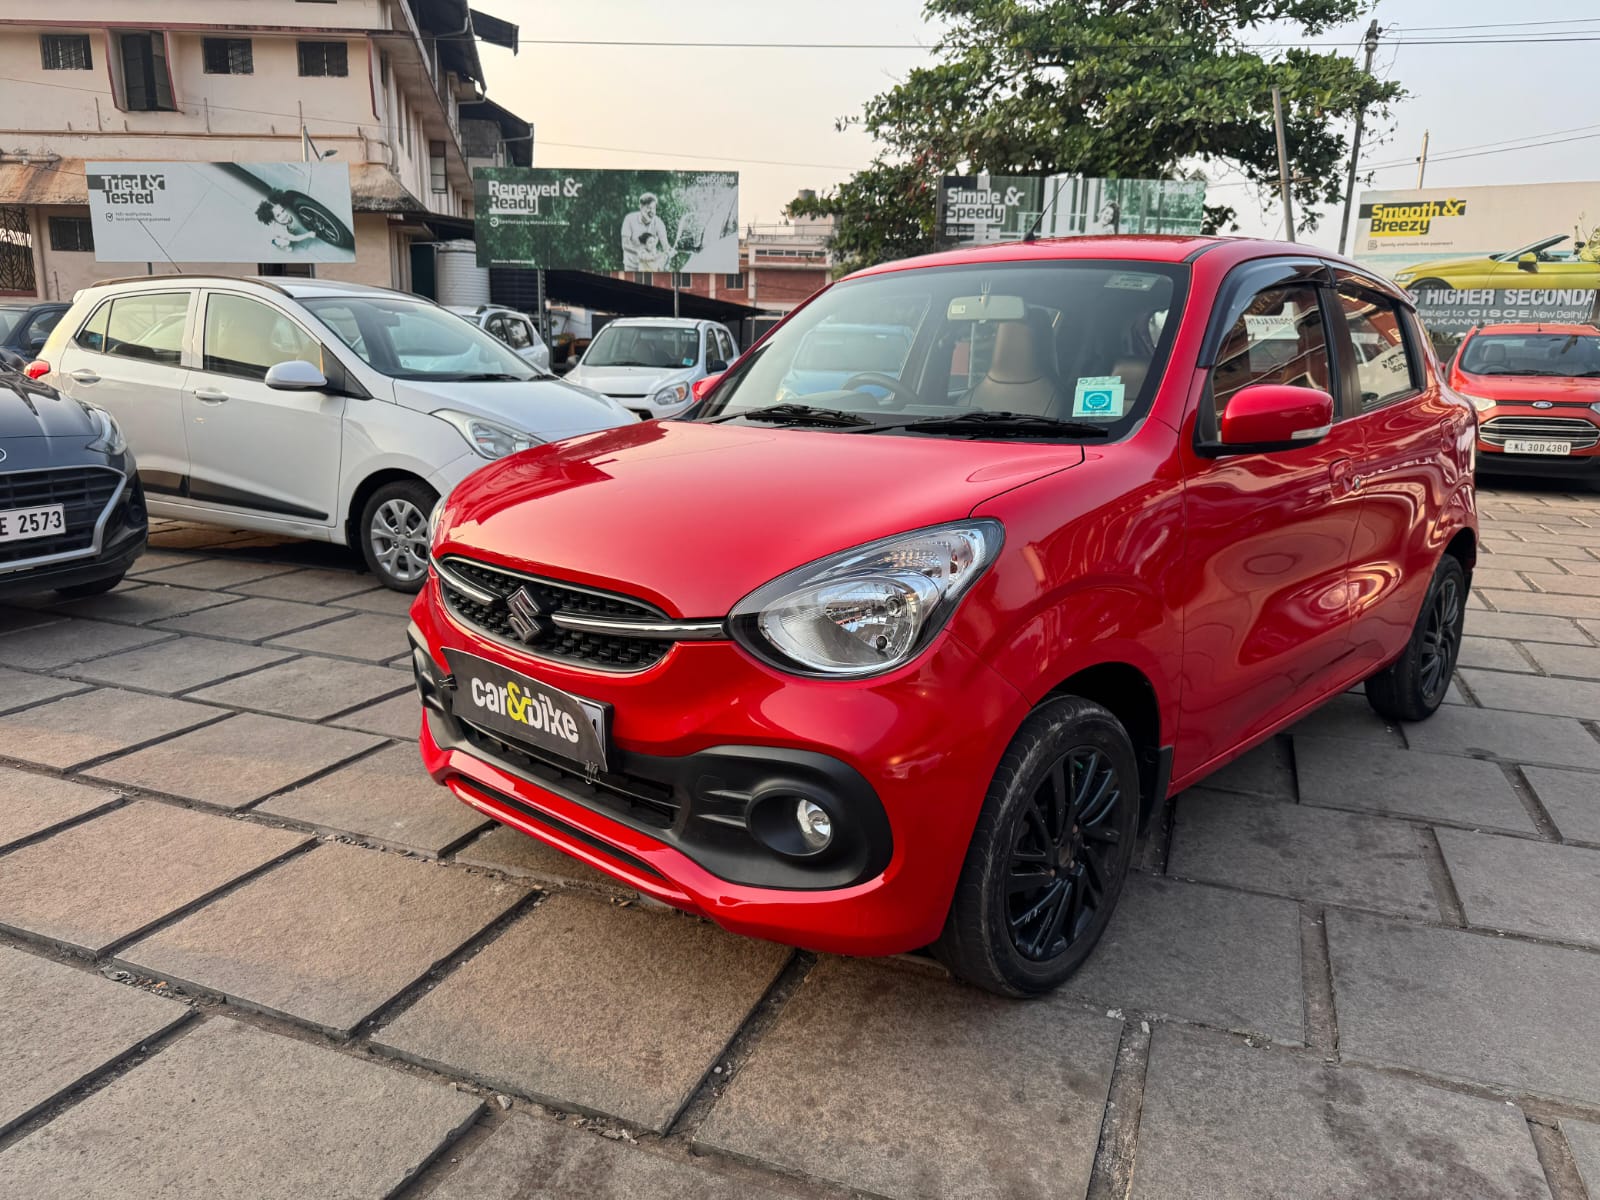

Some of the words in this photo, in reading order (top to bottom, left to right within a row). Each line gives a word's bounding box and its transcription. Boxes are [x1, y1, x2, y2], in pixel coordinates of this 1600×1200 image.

[100, 175, 142, 190] Tried
[145, 174, 164, 190] &
[488, 180, 560, 197] Renewed
[563, 177, 583, 197] &
[102, 190, 154, 204] Tested
[489, 195, 537, 214] Ready
[947, 186, 1001, 205] Simple
[1004, 186, 1026, 206] &
[947, 205, 1005, 223] Speedy
[1371, 200, 1440, 219] Smooth
[1442, 197, 1467, 216] &
[1370, 218, 1431, 235] Breezy
[1425, 289, 1496, 305] HIGHER
[1453, 309, 1465, 317] to
[18, 510, 62, 534] 2573
[471, 677, 579, 743] car&bike
